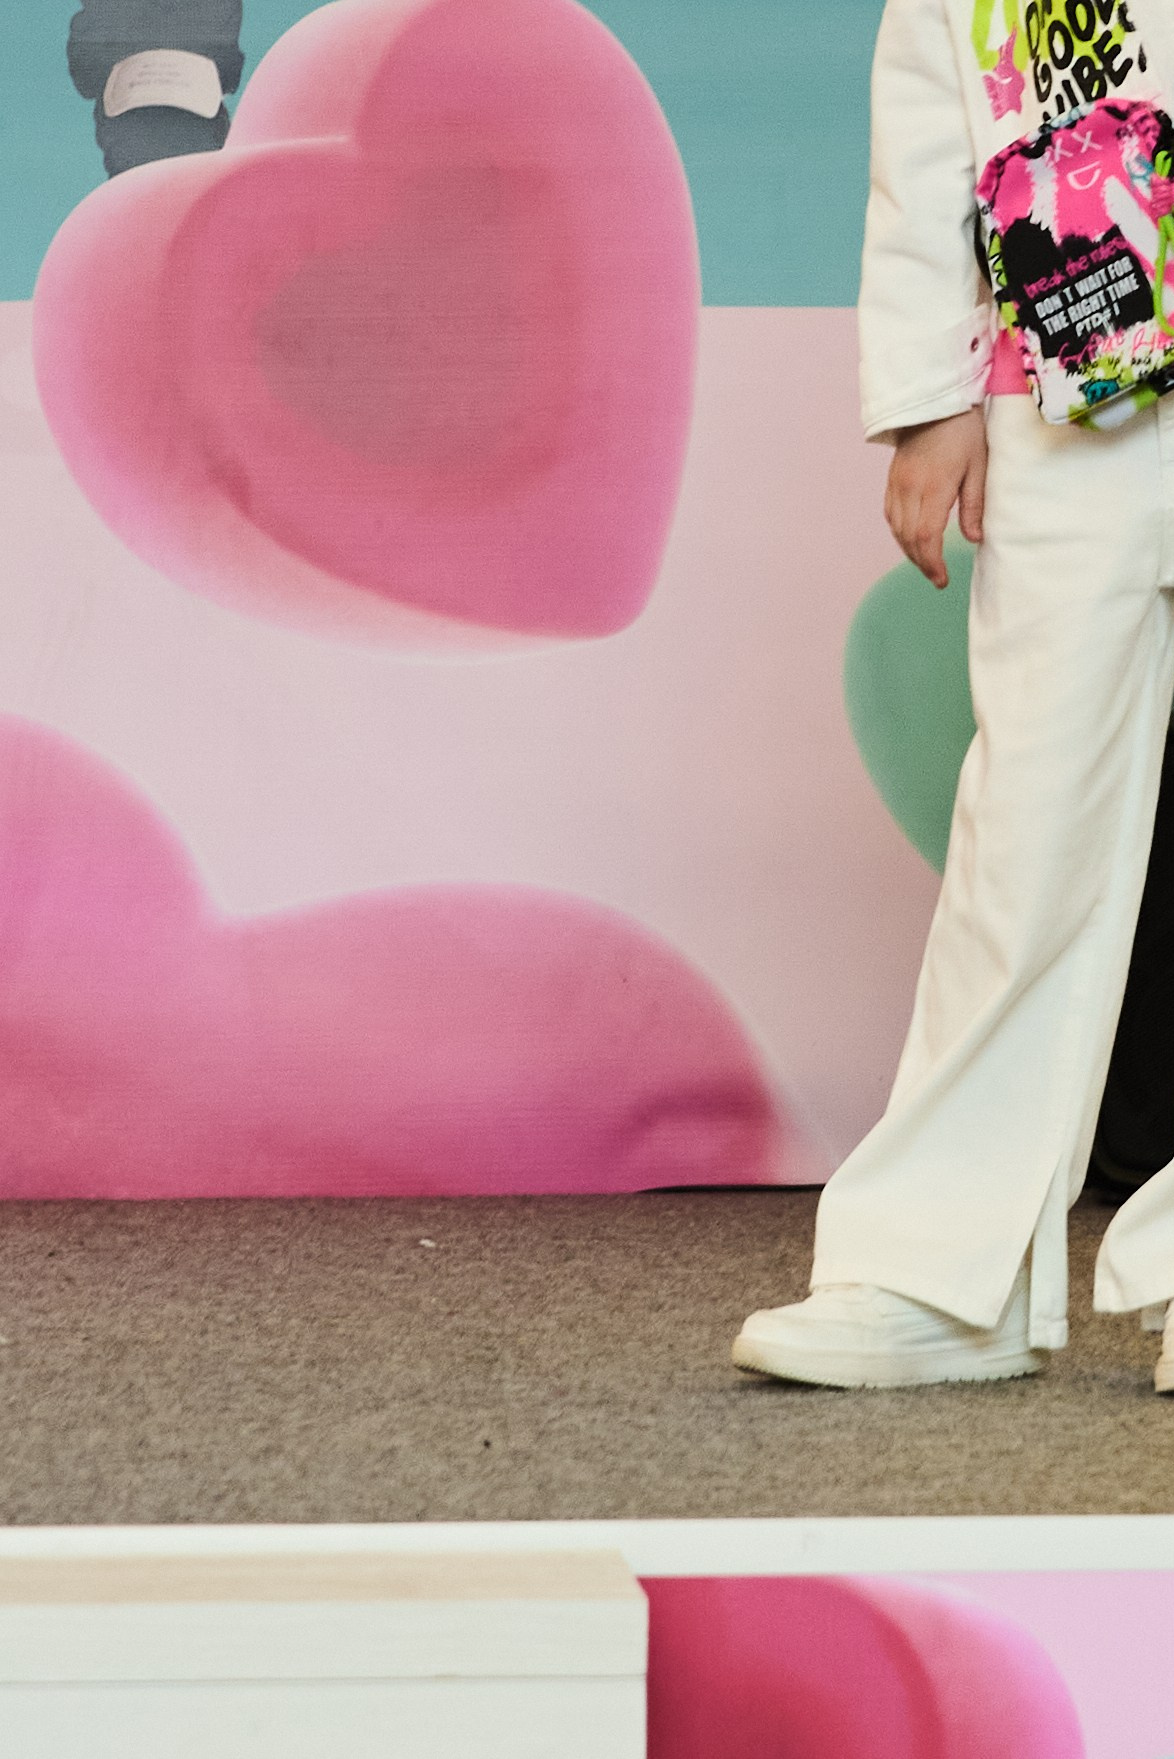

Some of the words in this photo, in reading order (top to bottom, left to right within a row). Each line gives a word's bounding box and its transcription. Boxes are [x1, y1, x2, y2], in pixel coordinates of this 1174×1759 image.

[1065, 257, 1090, 277] the
[1074, 267, 1109, 298] WAIT
[1107, 255, 1134, 281] FOR
[1042, 310, 1070, 336] THE
[1067, 289, 1107, 324] RIGHT
[1106, 272, 1140, 302] TIME
